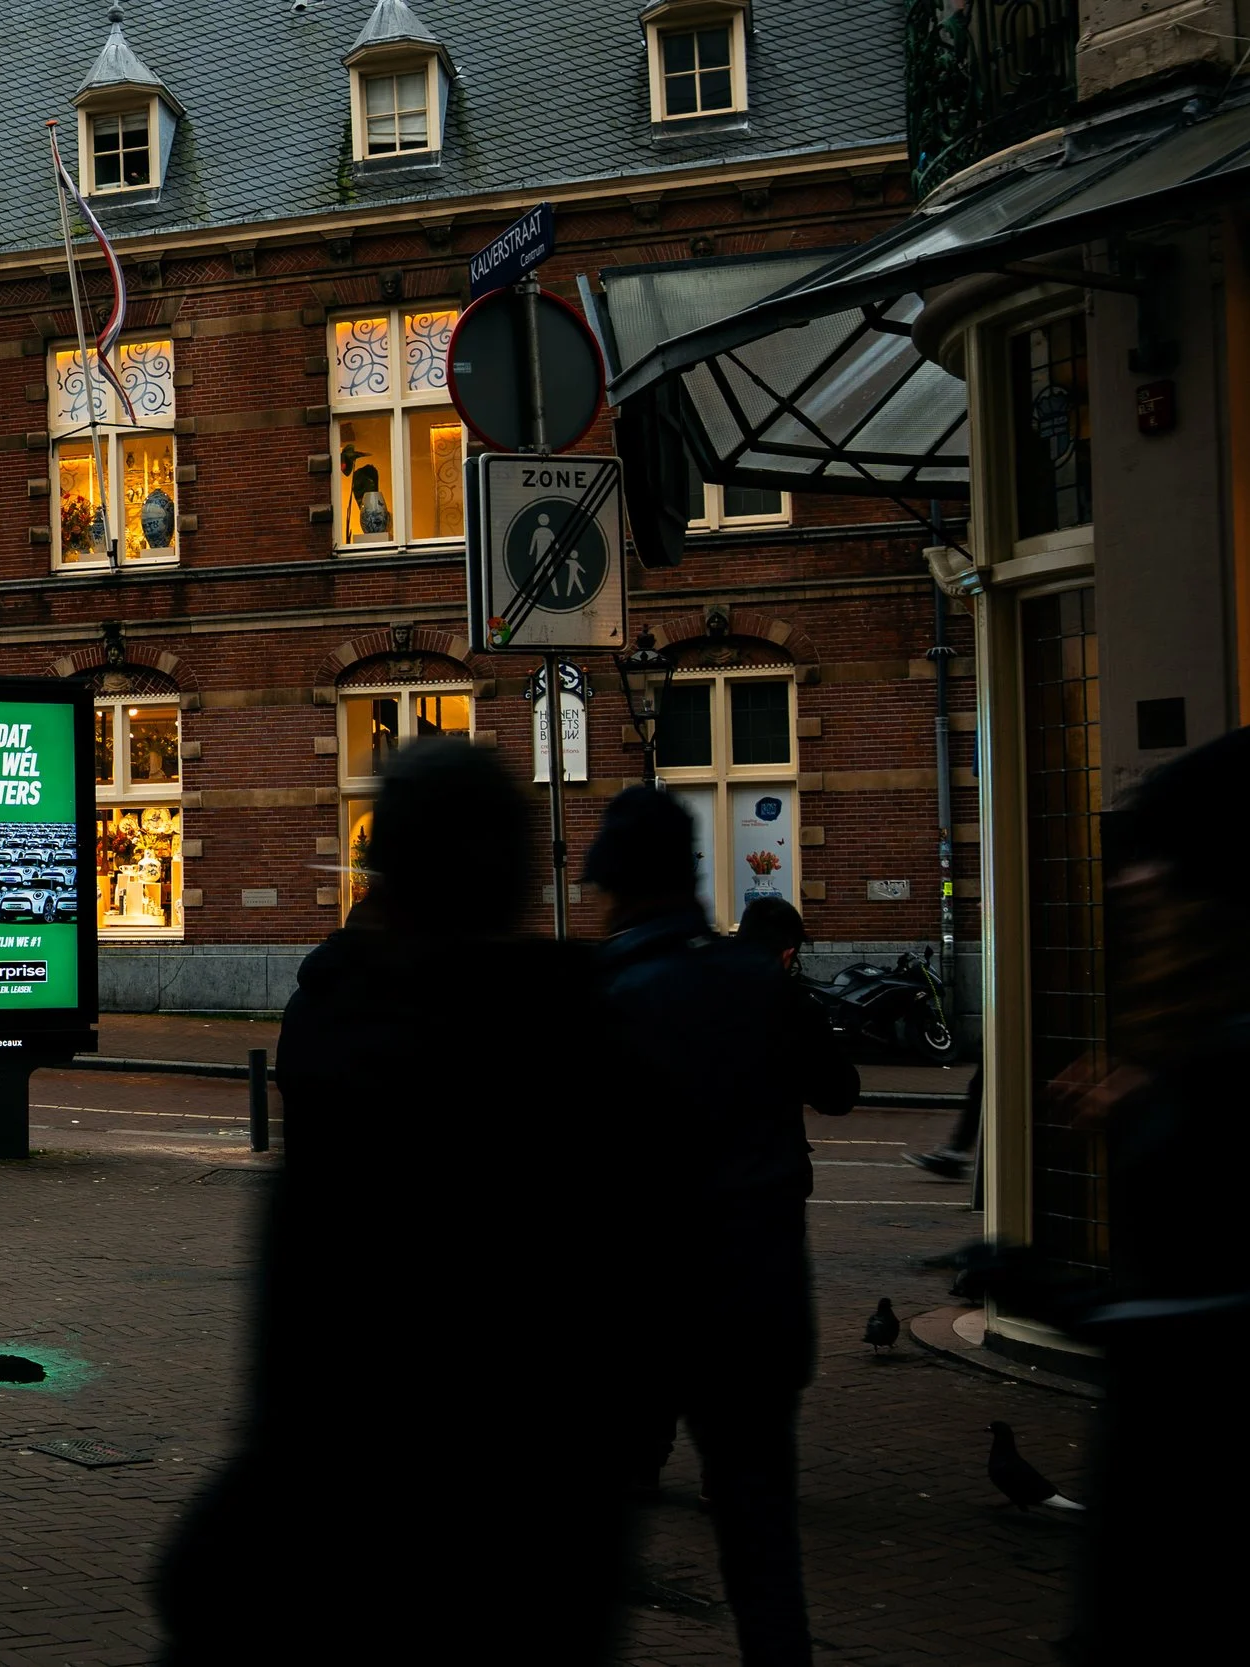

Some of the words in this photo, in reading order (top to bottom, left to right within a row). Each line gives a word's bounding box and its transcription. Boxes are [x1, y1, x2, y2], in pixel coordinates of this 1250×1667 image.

[470, 209, 542, 284] KALVERSTRAAT
[520, 243, 545, 267] Centrum
[522, 469, 587, 489] ZONE
[540, 708, 579, 720] HNEN
[2, 745, 41, 777] WÉL
[16, 936, 30, 948] WE
[30, 936, 42, 948] #1
